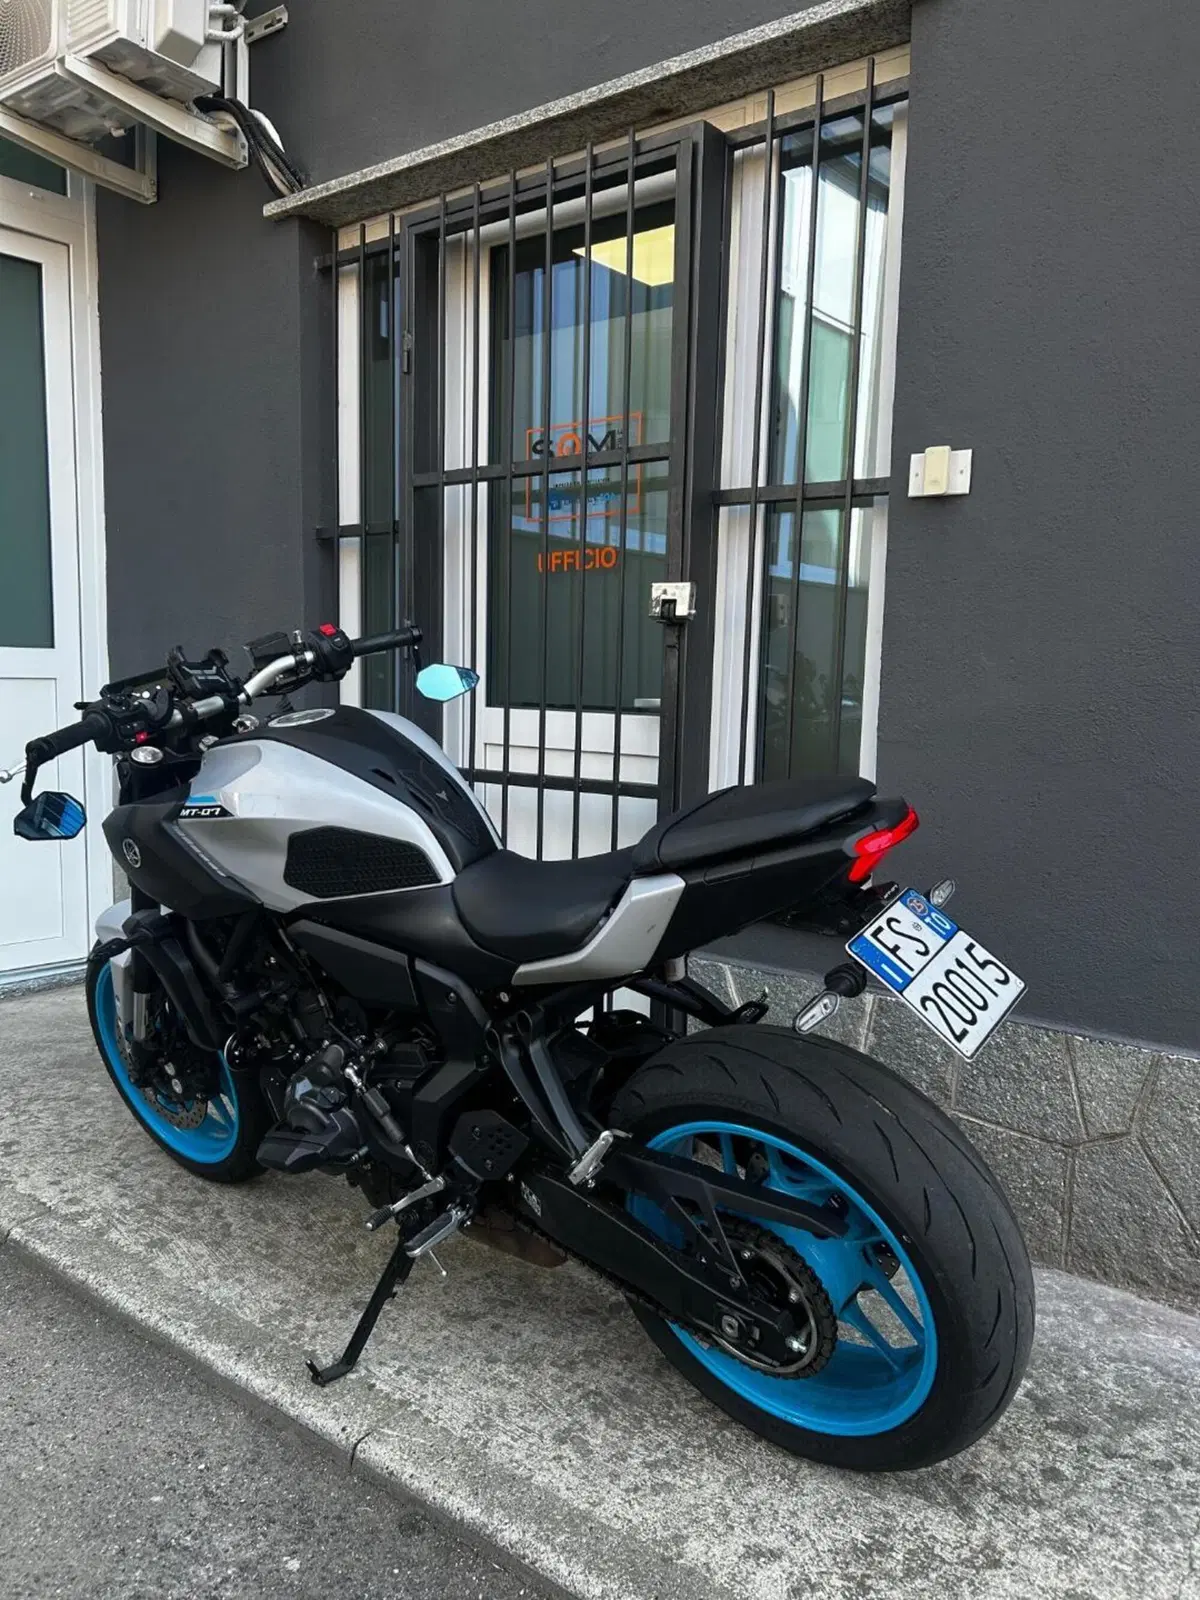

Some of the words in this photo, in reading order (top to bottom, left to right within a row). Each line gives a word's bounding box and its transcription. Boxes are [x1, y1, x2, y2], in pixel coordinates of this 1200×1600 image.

[179, 808, 221, 817] MT-07
[925, 912, 951, 936] TO
[870, 917, 930, 972] FS
[881, 962, 903, 984] I
[920, 942, 1010, 1044] 20015
